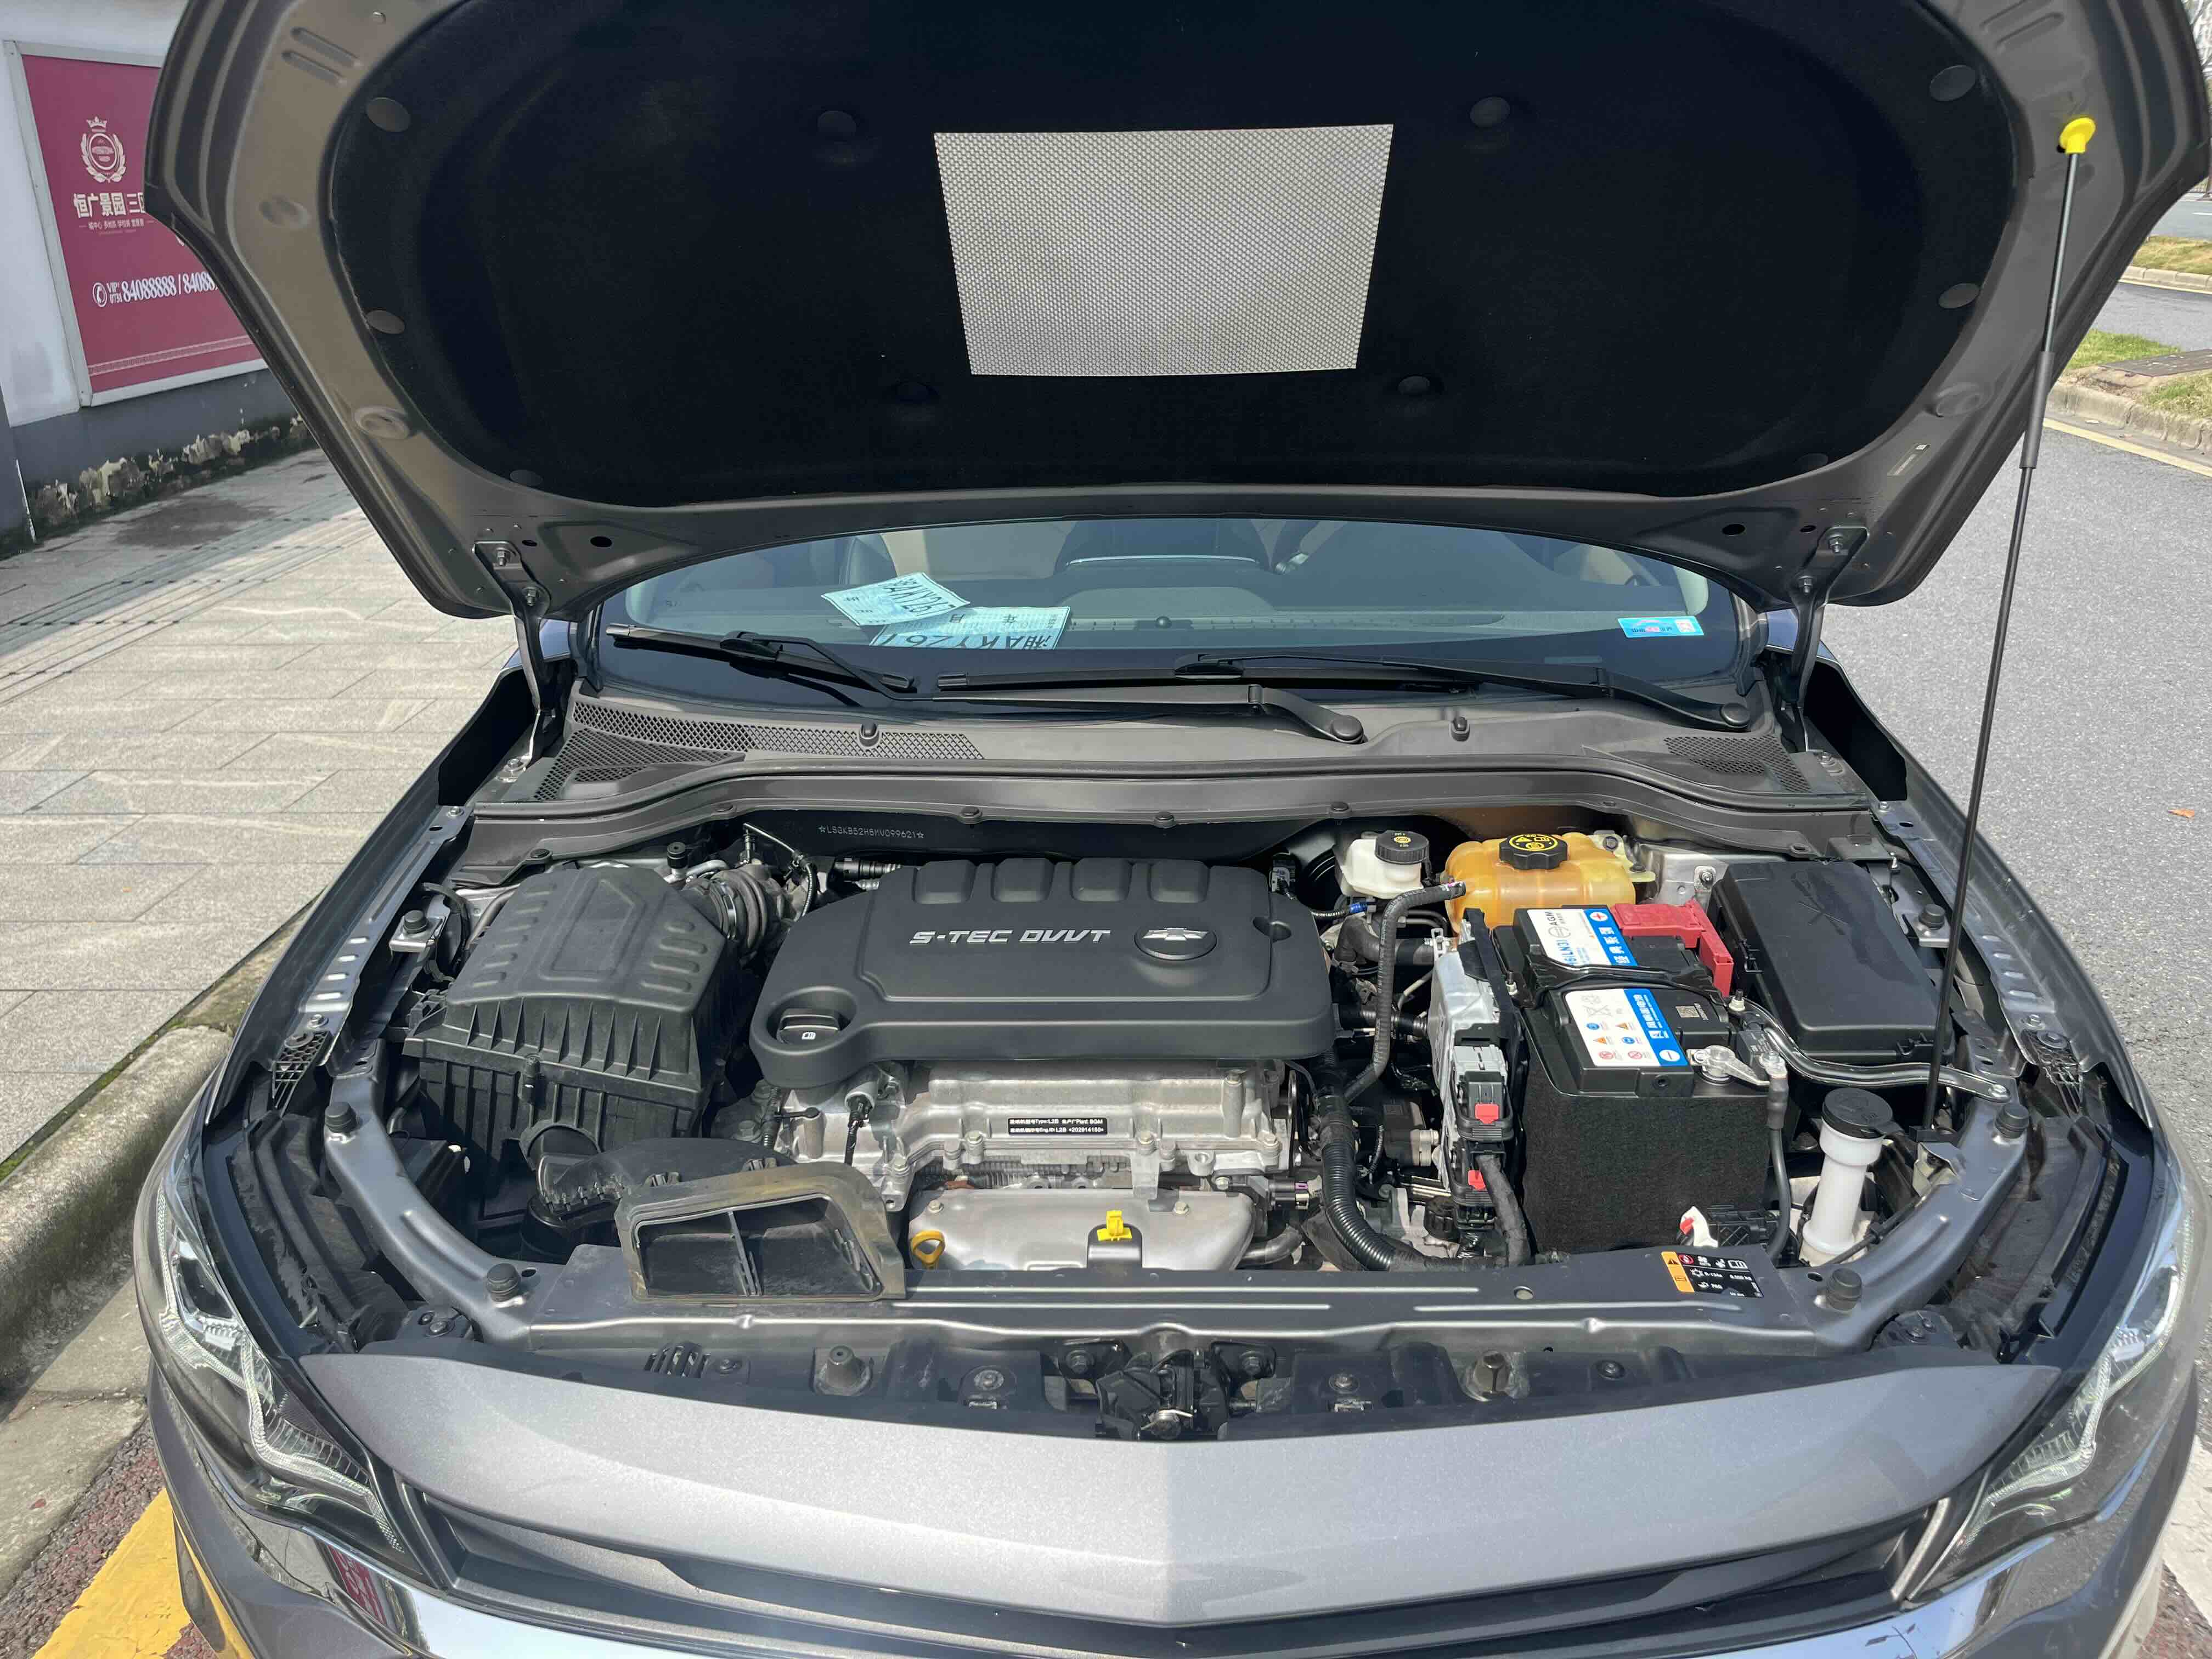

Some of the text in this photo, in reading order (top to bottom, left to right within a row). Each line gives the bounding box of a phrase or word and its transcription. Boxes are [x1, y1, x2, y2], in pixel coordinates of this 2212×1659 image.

[121, 275, 177, 303] 84088888
[183, 270, 218, 294] 84088
[1544, 911, 1559, 926] AGM
[909, 929, 1111, 944] S-TEC DVVT
